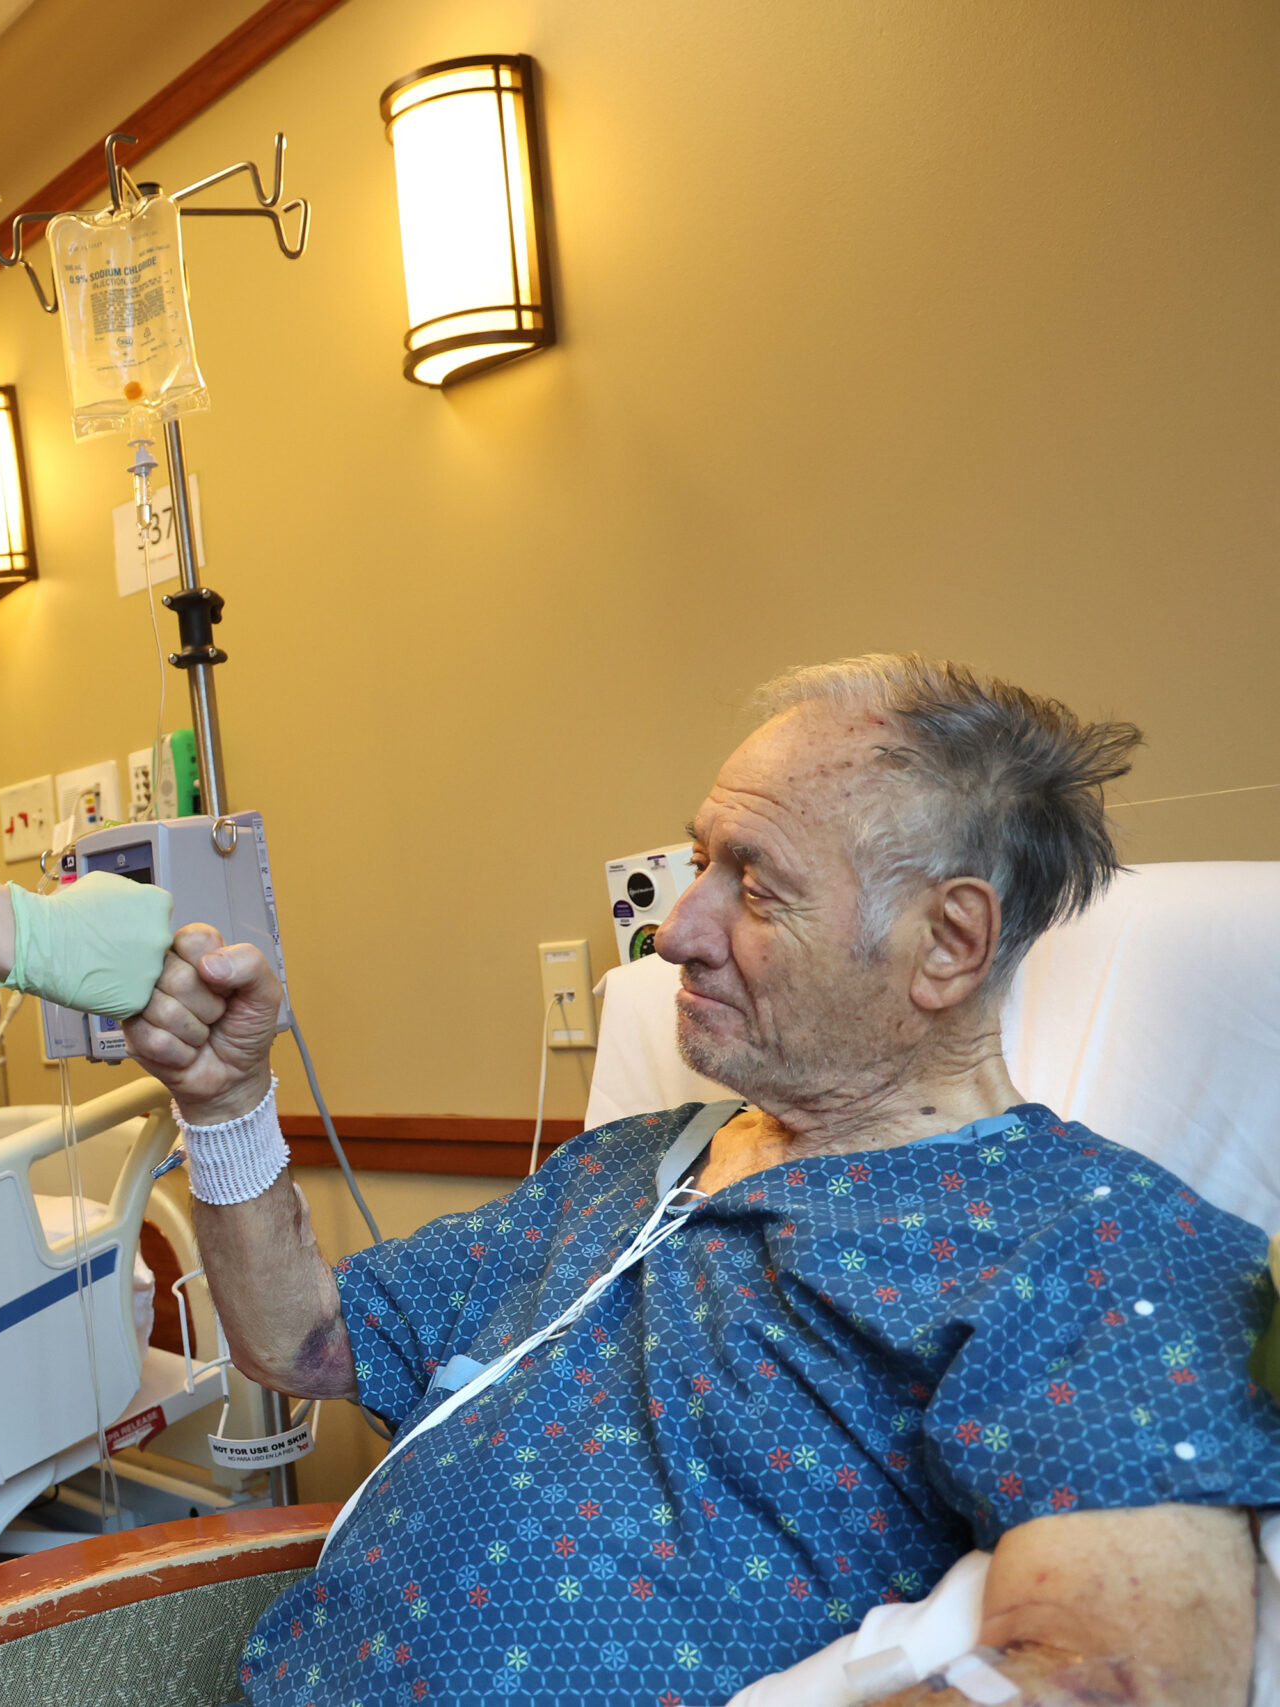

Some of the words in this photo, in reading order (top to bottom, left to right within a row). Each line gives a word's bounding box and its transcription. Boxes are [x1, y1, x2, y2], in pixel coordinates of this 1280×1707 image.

[69, 274, 88, 284] 0.9%
[89, 267, 121, 282] SODIUM
[123, 256, 157, 276] CHLORIDE
[120, 1410, 158, 1436] RELEASE
[212, 1444, 228, 1454] NOT
[230, 1447, 247, 1455] FOR
[249, 1445, 269, 1455] USE
[271, 1442, 285, 1451] ON
[287, 1431, 307, 1446] SKIN
